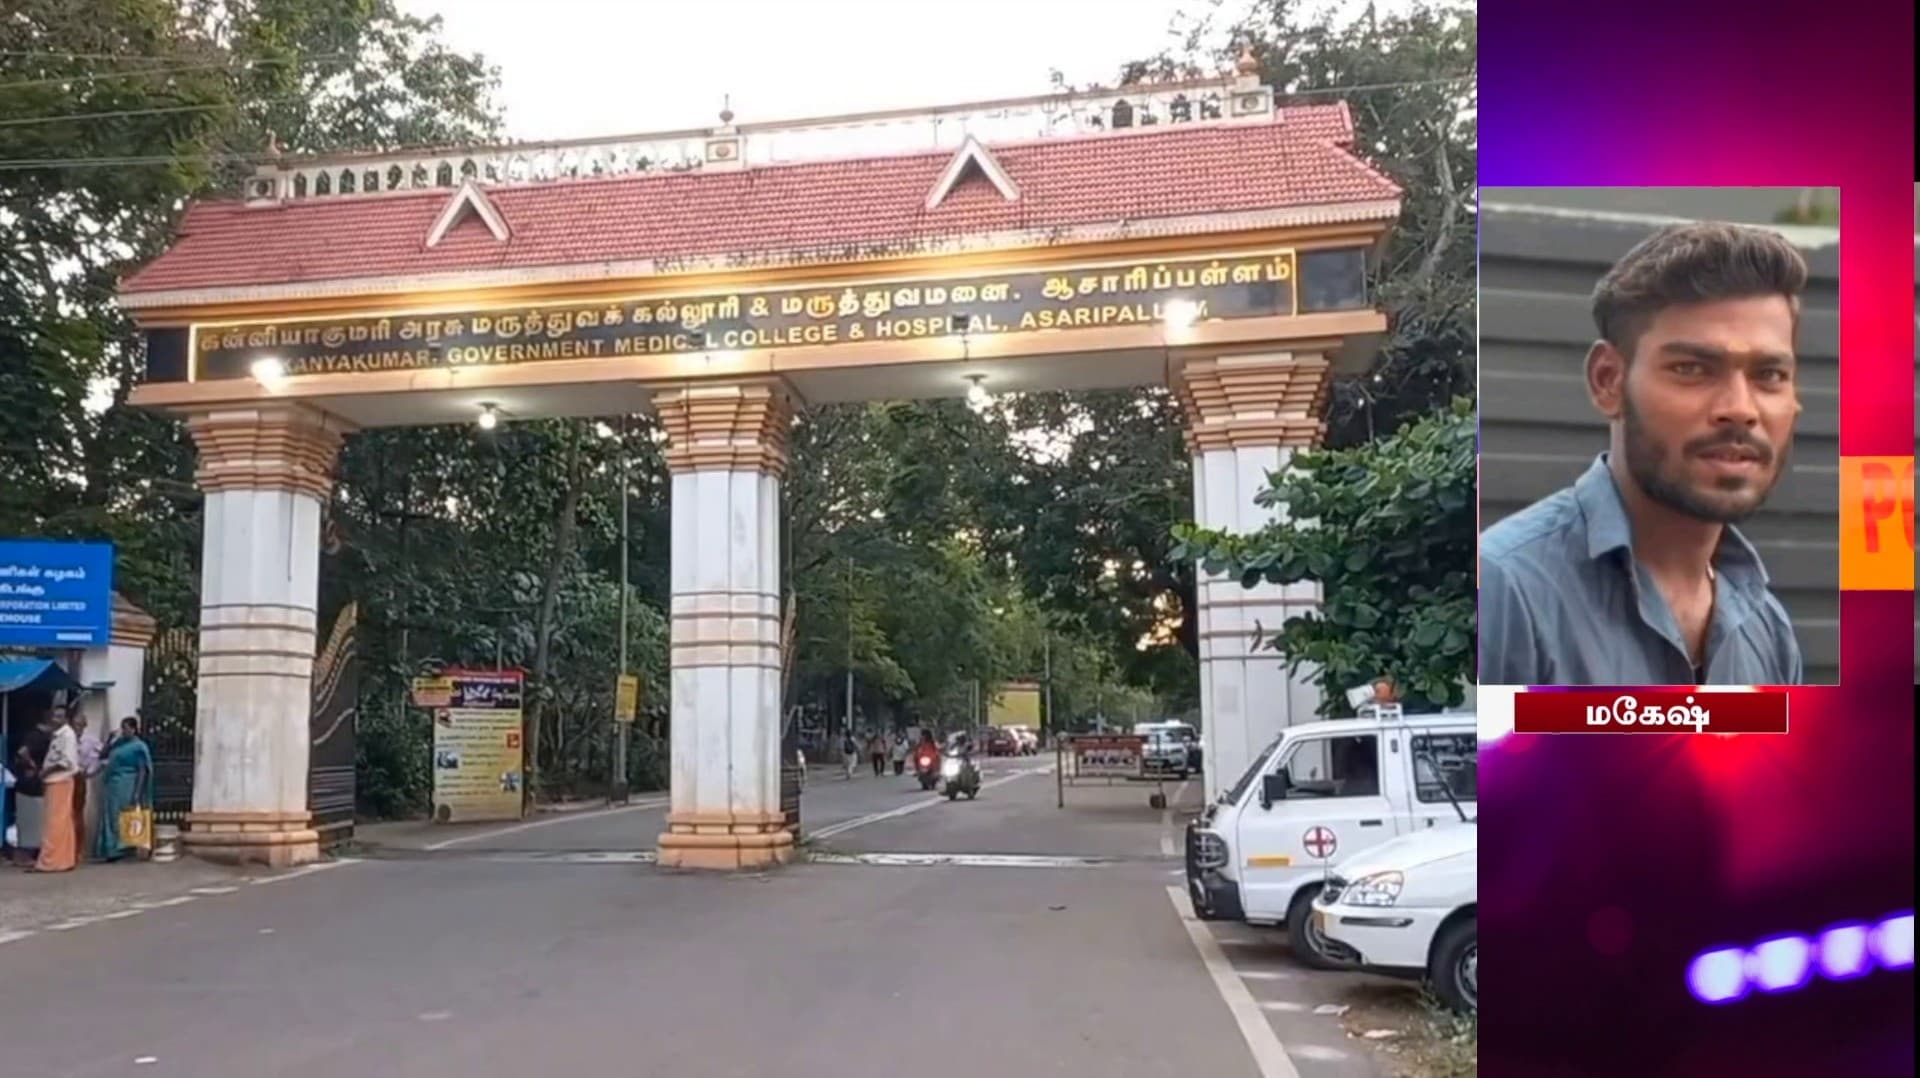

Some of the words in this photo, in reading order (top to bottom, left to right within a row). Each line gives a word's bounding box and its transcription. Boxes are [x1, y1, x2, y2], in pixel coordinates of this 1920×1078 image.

[200, 319, 391, 351] கன்னியாகுமரி
[399, 317, 465, 344] அரசு
[471, 305, 623, 339] மருத்துவக்
[632, 295, 740, 330] கல்லூரி
[749, 297, 769, 317] &
[1041, 257, 1291, 300] ஆசாரிப்பள்ளம்
[447, 340, 604, 364] GOVERNMENT
[614, 331, 719, 354] MEDICL
[723, 324, 838, 348] COLLEGE
[848, 322, 865, 339] &
[876, 313, 1008, 338] HOSPIAL,
